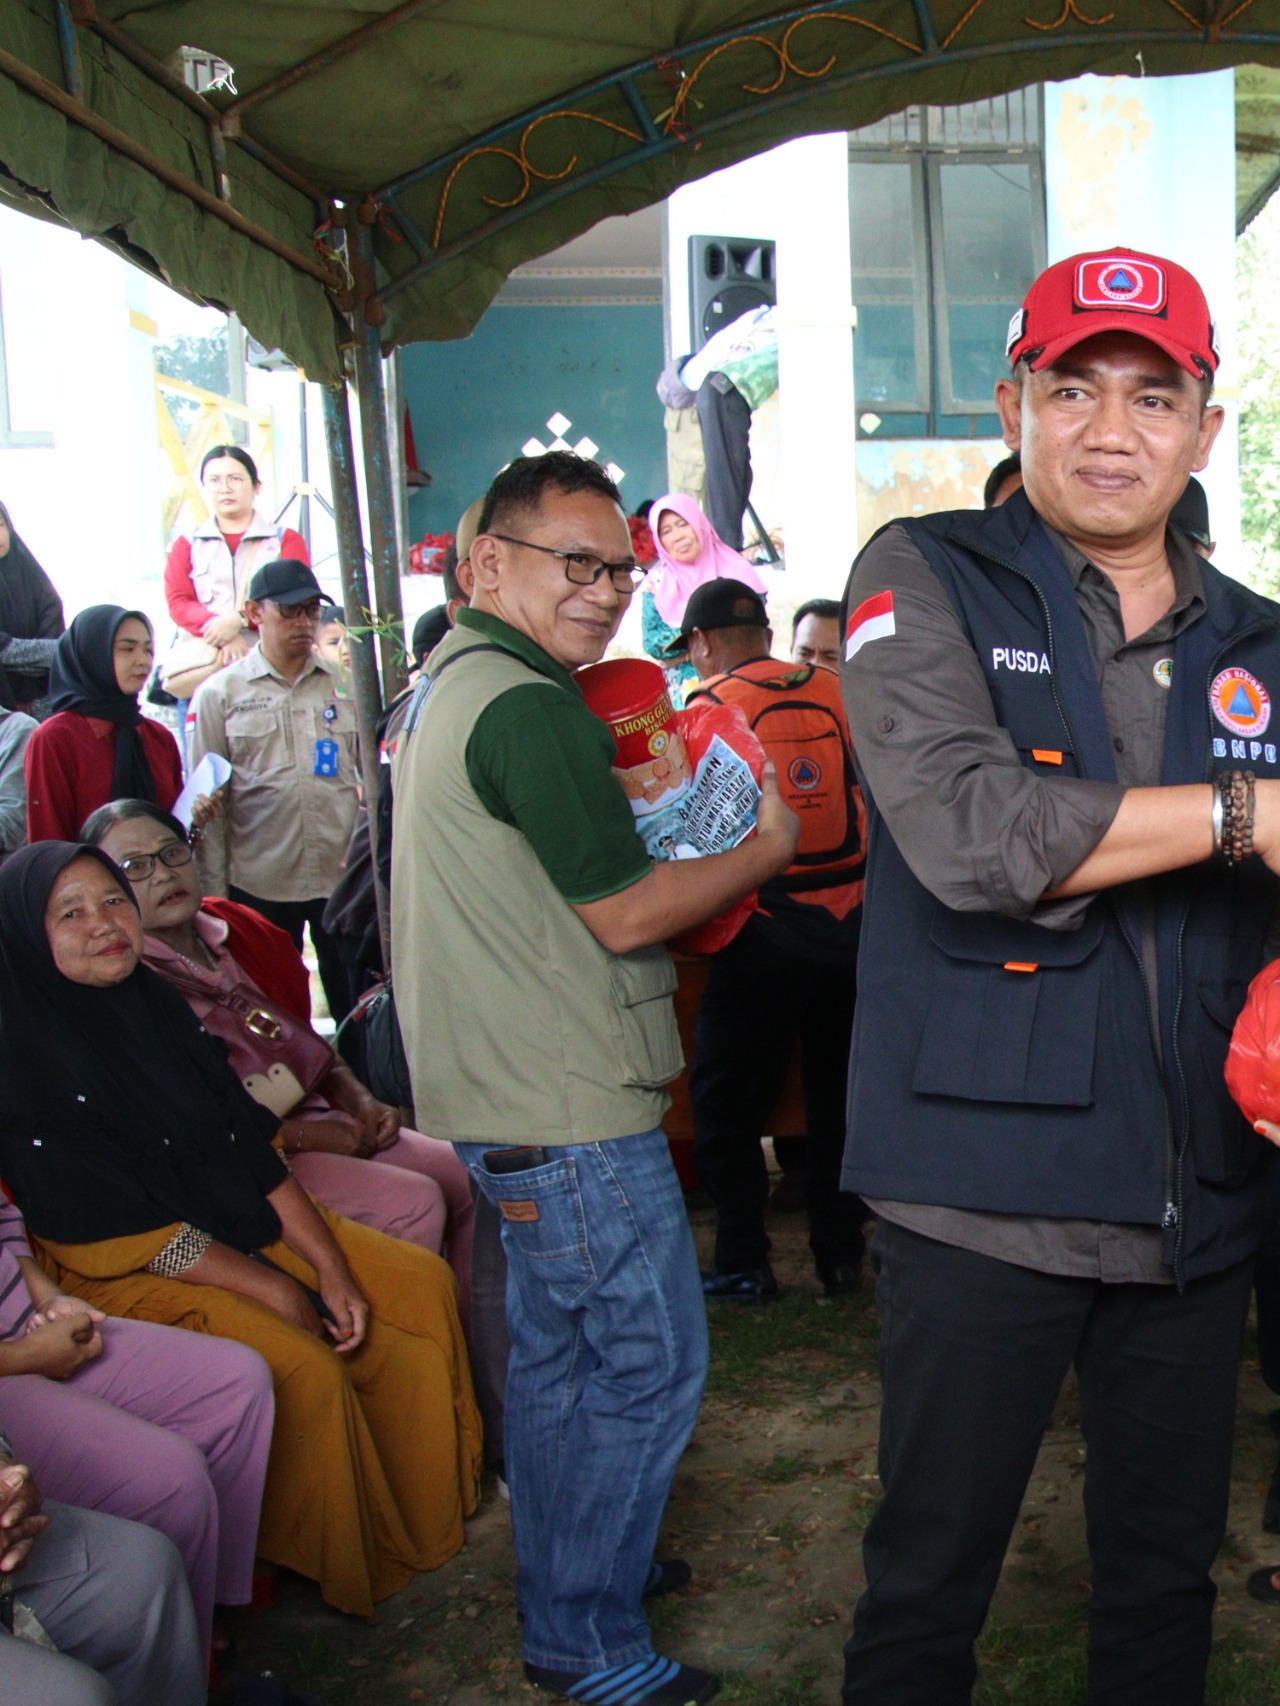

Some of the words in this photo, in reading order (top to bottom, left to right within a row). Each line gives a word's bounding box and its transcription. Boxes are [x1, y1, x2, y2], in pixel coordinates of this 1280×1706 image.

[992, 647, 1052, 675] PUSDA
[614, 710, 656, 738] KHONG
[1212, 737, 1277, 764] BNPB
[679, 756, 722, 821] BANTUAN
